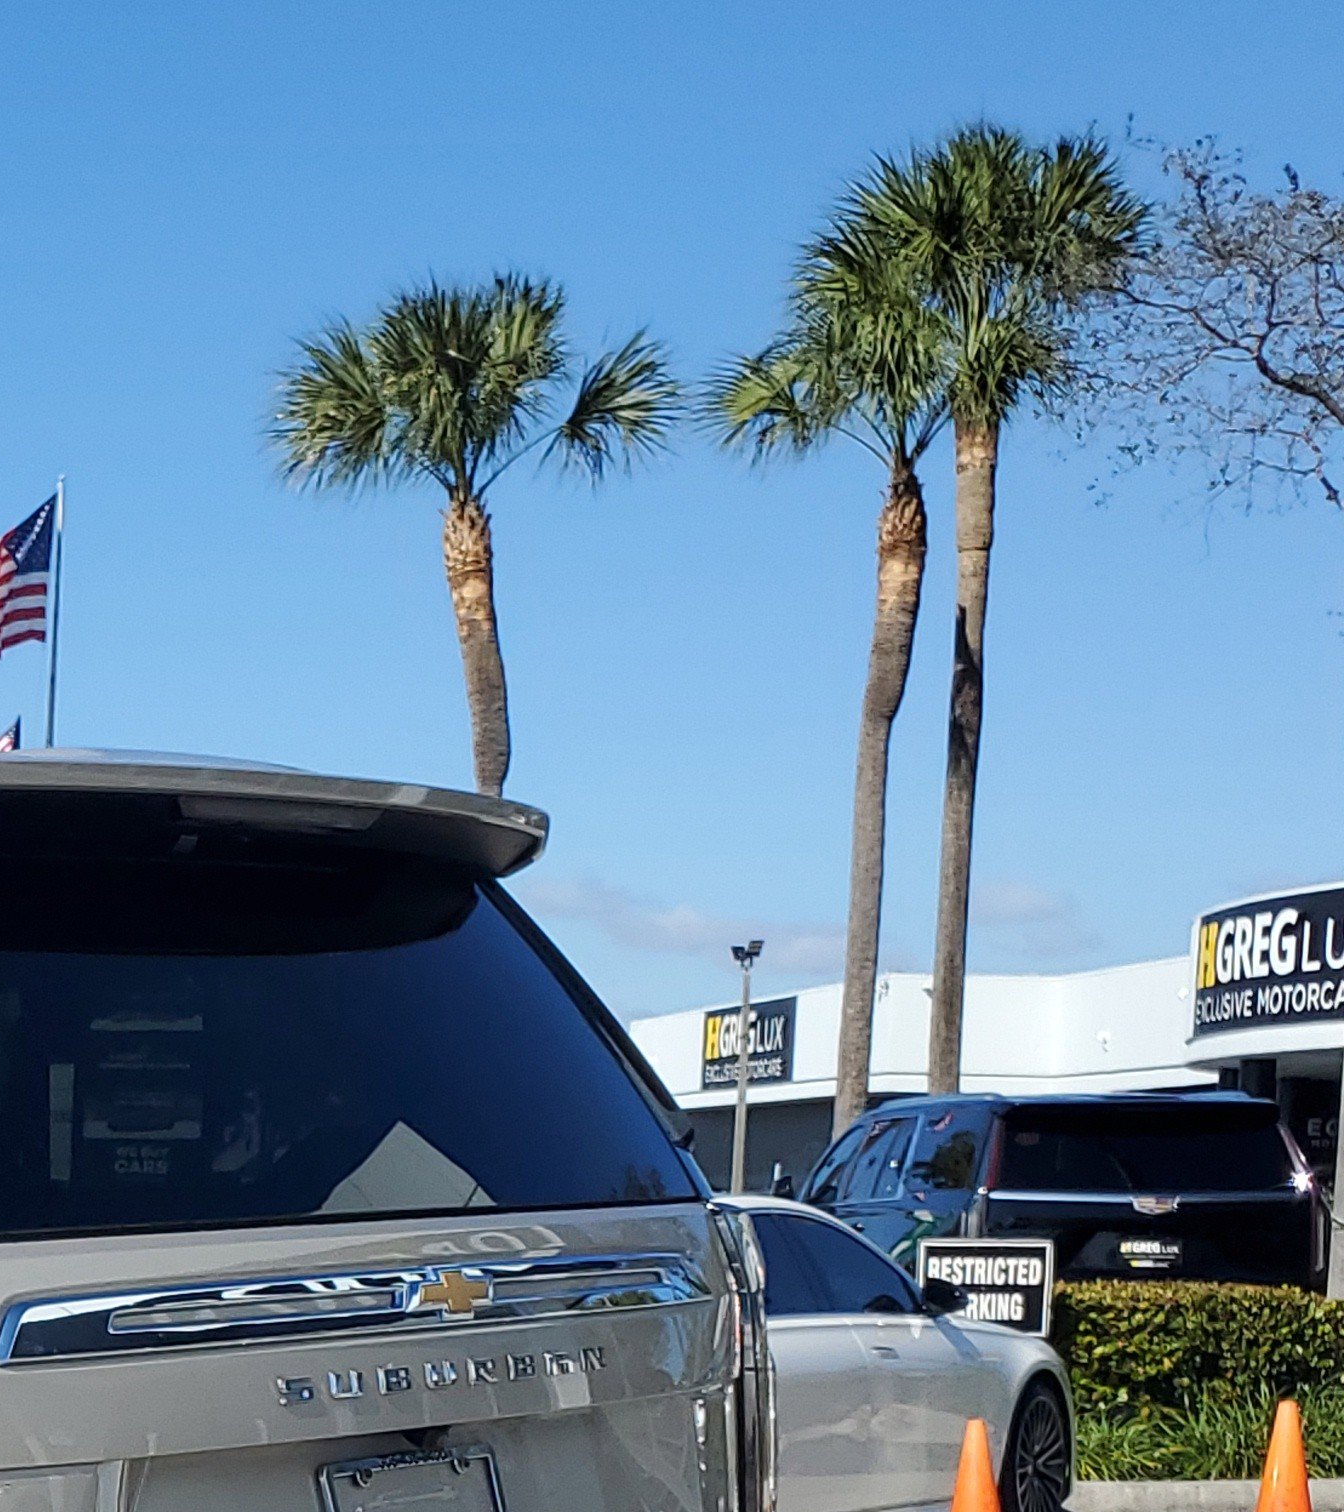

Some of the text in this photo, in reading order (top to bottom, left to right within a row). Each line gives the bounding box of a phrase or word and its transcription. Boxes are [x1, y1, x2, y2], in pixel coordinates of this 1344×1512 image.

[1196, 989, 1253, 1025] EXCLUSIVE
[927, 1256, 1042, 1286] RESTRICTED
[952, 1292, 1024, 1321] RKING
[275, 1345, 608, 1406] SUBURBAN
